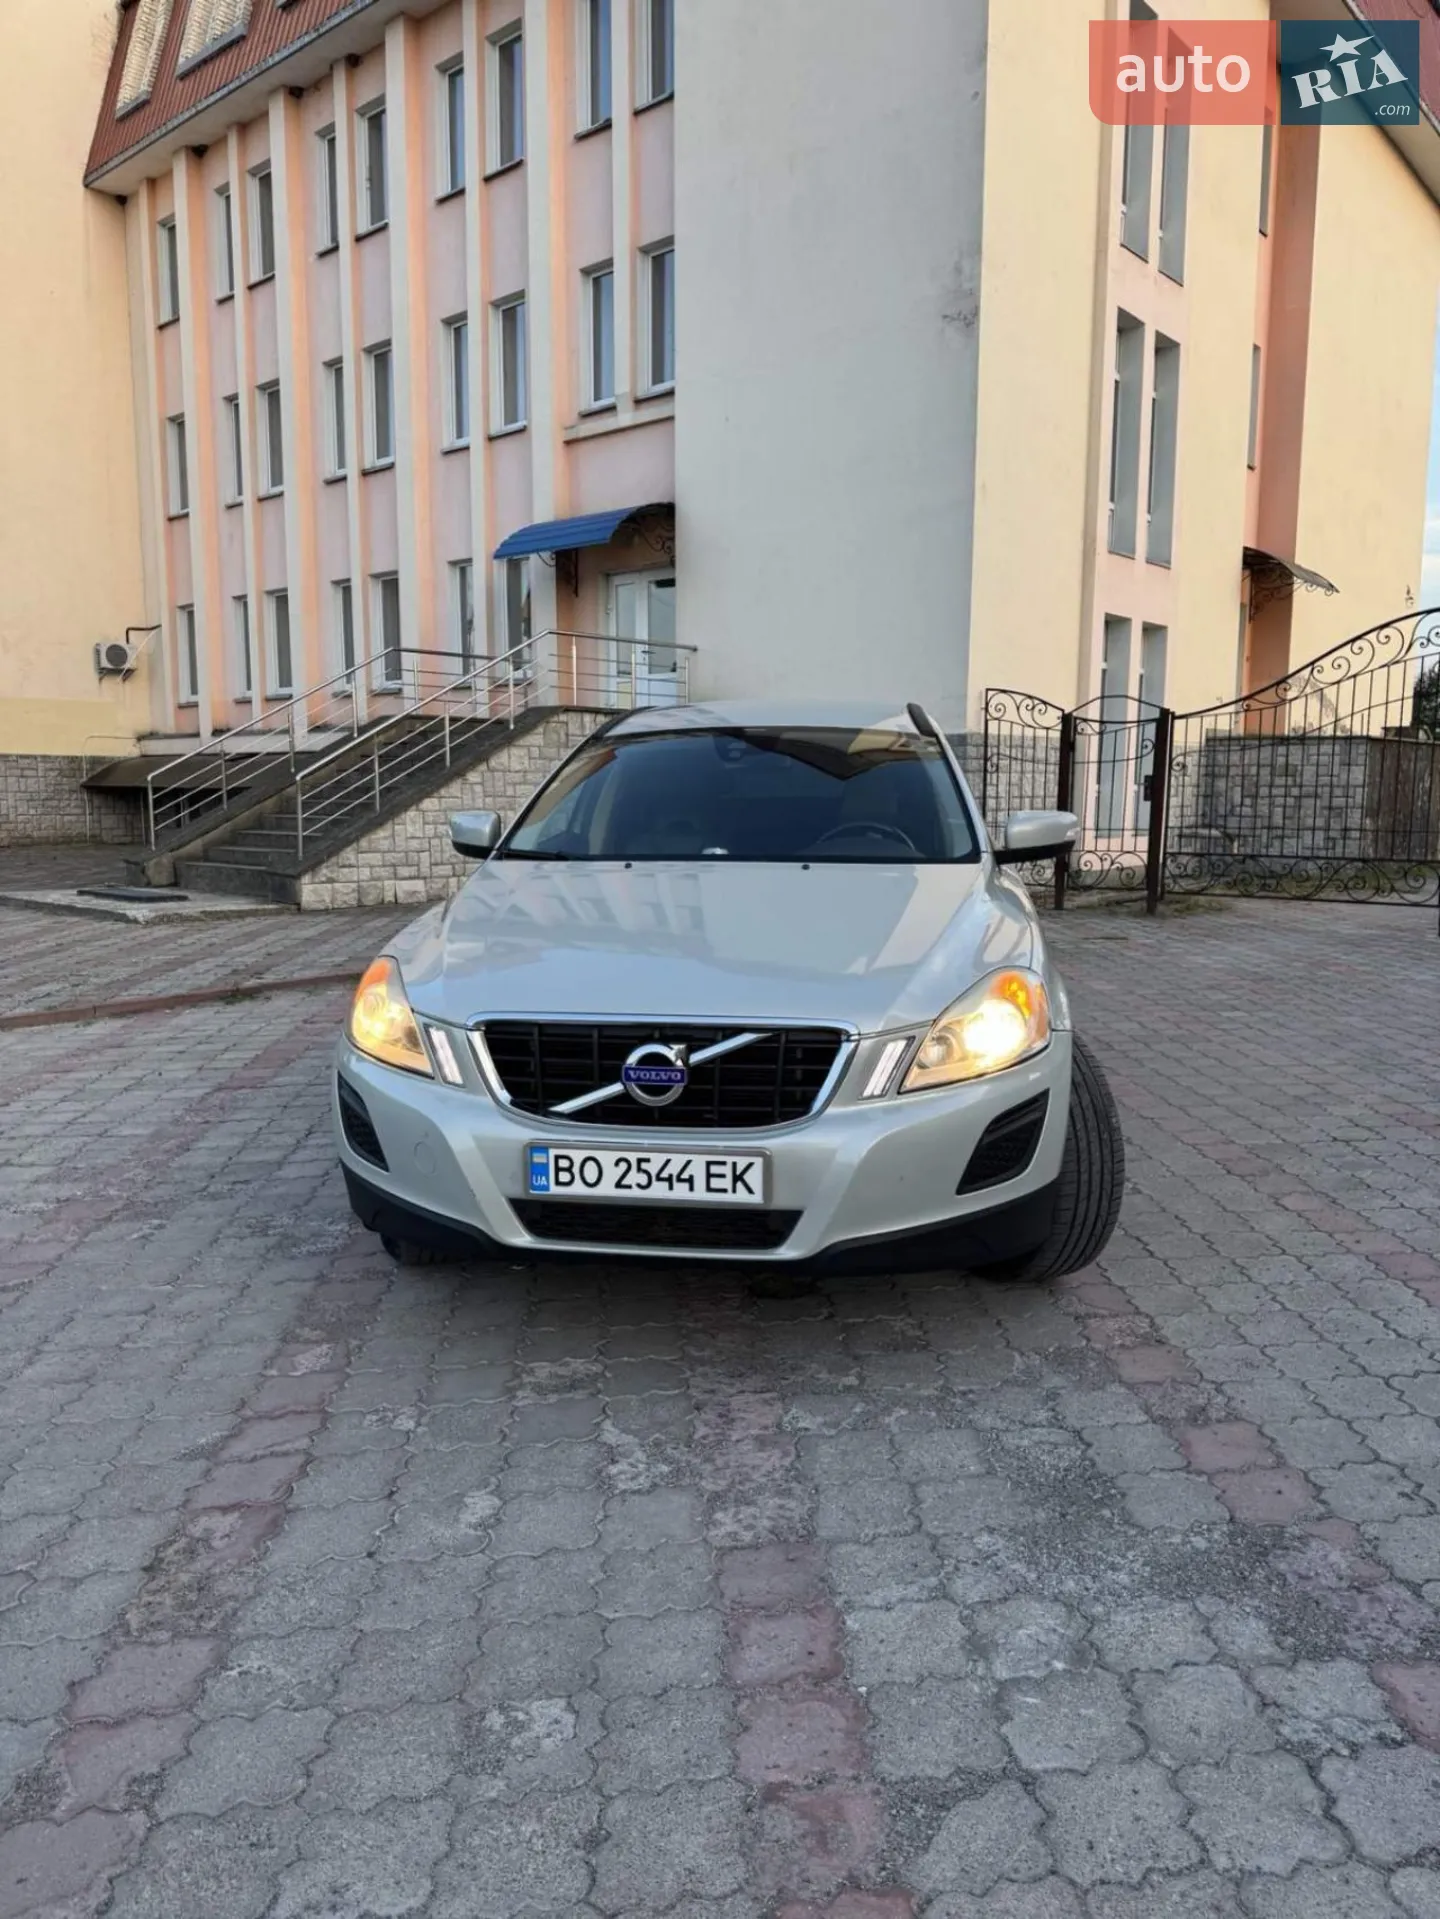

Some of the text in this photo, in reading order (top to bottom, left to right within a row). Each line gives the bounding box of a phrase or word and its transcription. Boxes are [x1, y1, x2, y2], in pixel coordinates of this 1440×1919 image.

[627, 1069, 682, 1081] VOLVO
[553, 1154, 756, 1195] BO 2544 EK
[532, 1176, 548, 1186] UA
